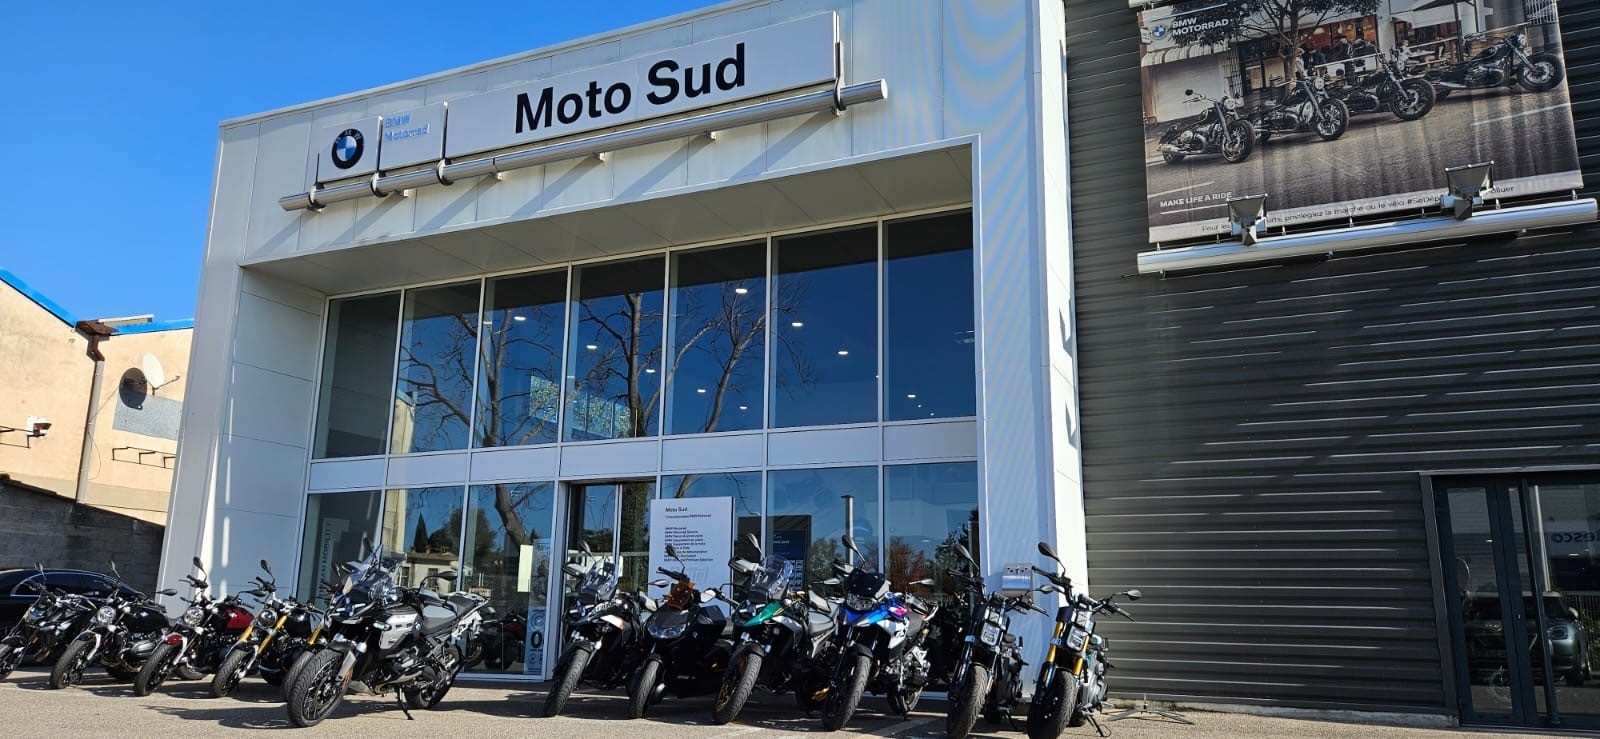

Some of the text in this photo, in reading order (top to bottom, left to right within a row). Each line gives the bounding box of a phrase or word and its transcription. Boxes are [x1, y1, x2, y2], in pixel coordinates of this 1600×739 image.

[1172, 17, 1197, 28] BMW
[1172, 18, 1229, 36] MOTORRAD
[515, 42, 745, 134] Moto Sud
[385, 112, 411, 128] BMW
[384, 123, 430, 141] Motorrad
[1160, 191, 1232, 208] MAKE LIFE A RIDE
